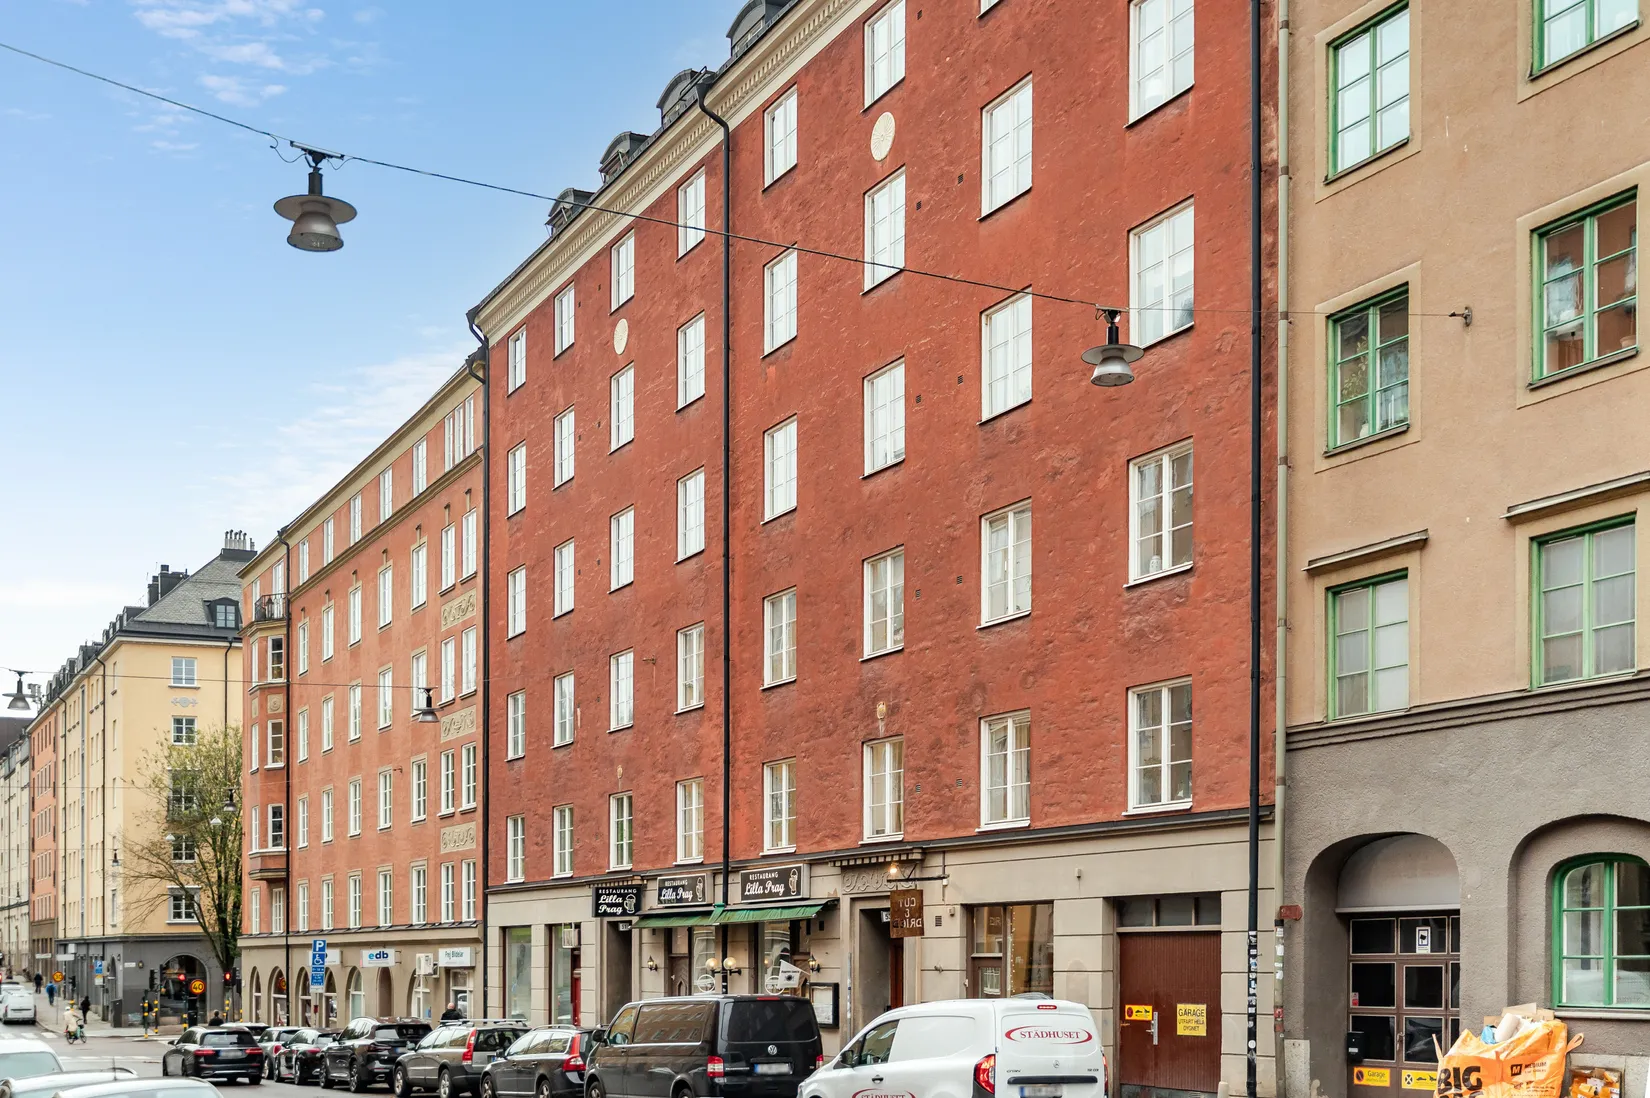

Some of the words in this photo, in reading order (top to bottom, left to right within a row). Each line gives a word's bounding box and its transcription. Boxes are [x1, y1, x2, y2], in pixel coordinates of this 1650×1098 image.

[749, 871, 779, 881] RESTAURANG
[664, 879, 688, 887] RESTAURANG
[744, 882, 764, 896] Lilla
[764, 880, 785, 897] Prag
[598, 894, 623, 904] Lilla
[660, 887, 676, 900] Lilla
[676, 887, 693, 902] Prag
[598, 904, 623, 915] Prag
[316, 941, 324, 952] P
[368, 951, 389, 960] edb
[192, 982, 203, 991] 40
[1178, 1008, 1205, 1018] GARAGE
[1020, 1029, 1080, 1039] STÄDHUSET
[1367, 1070, 1386, 1079] Garage
[1437, 1065, 1483, 1095] BIG
